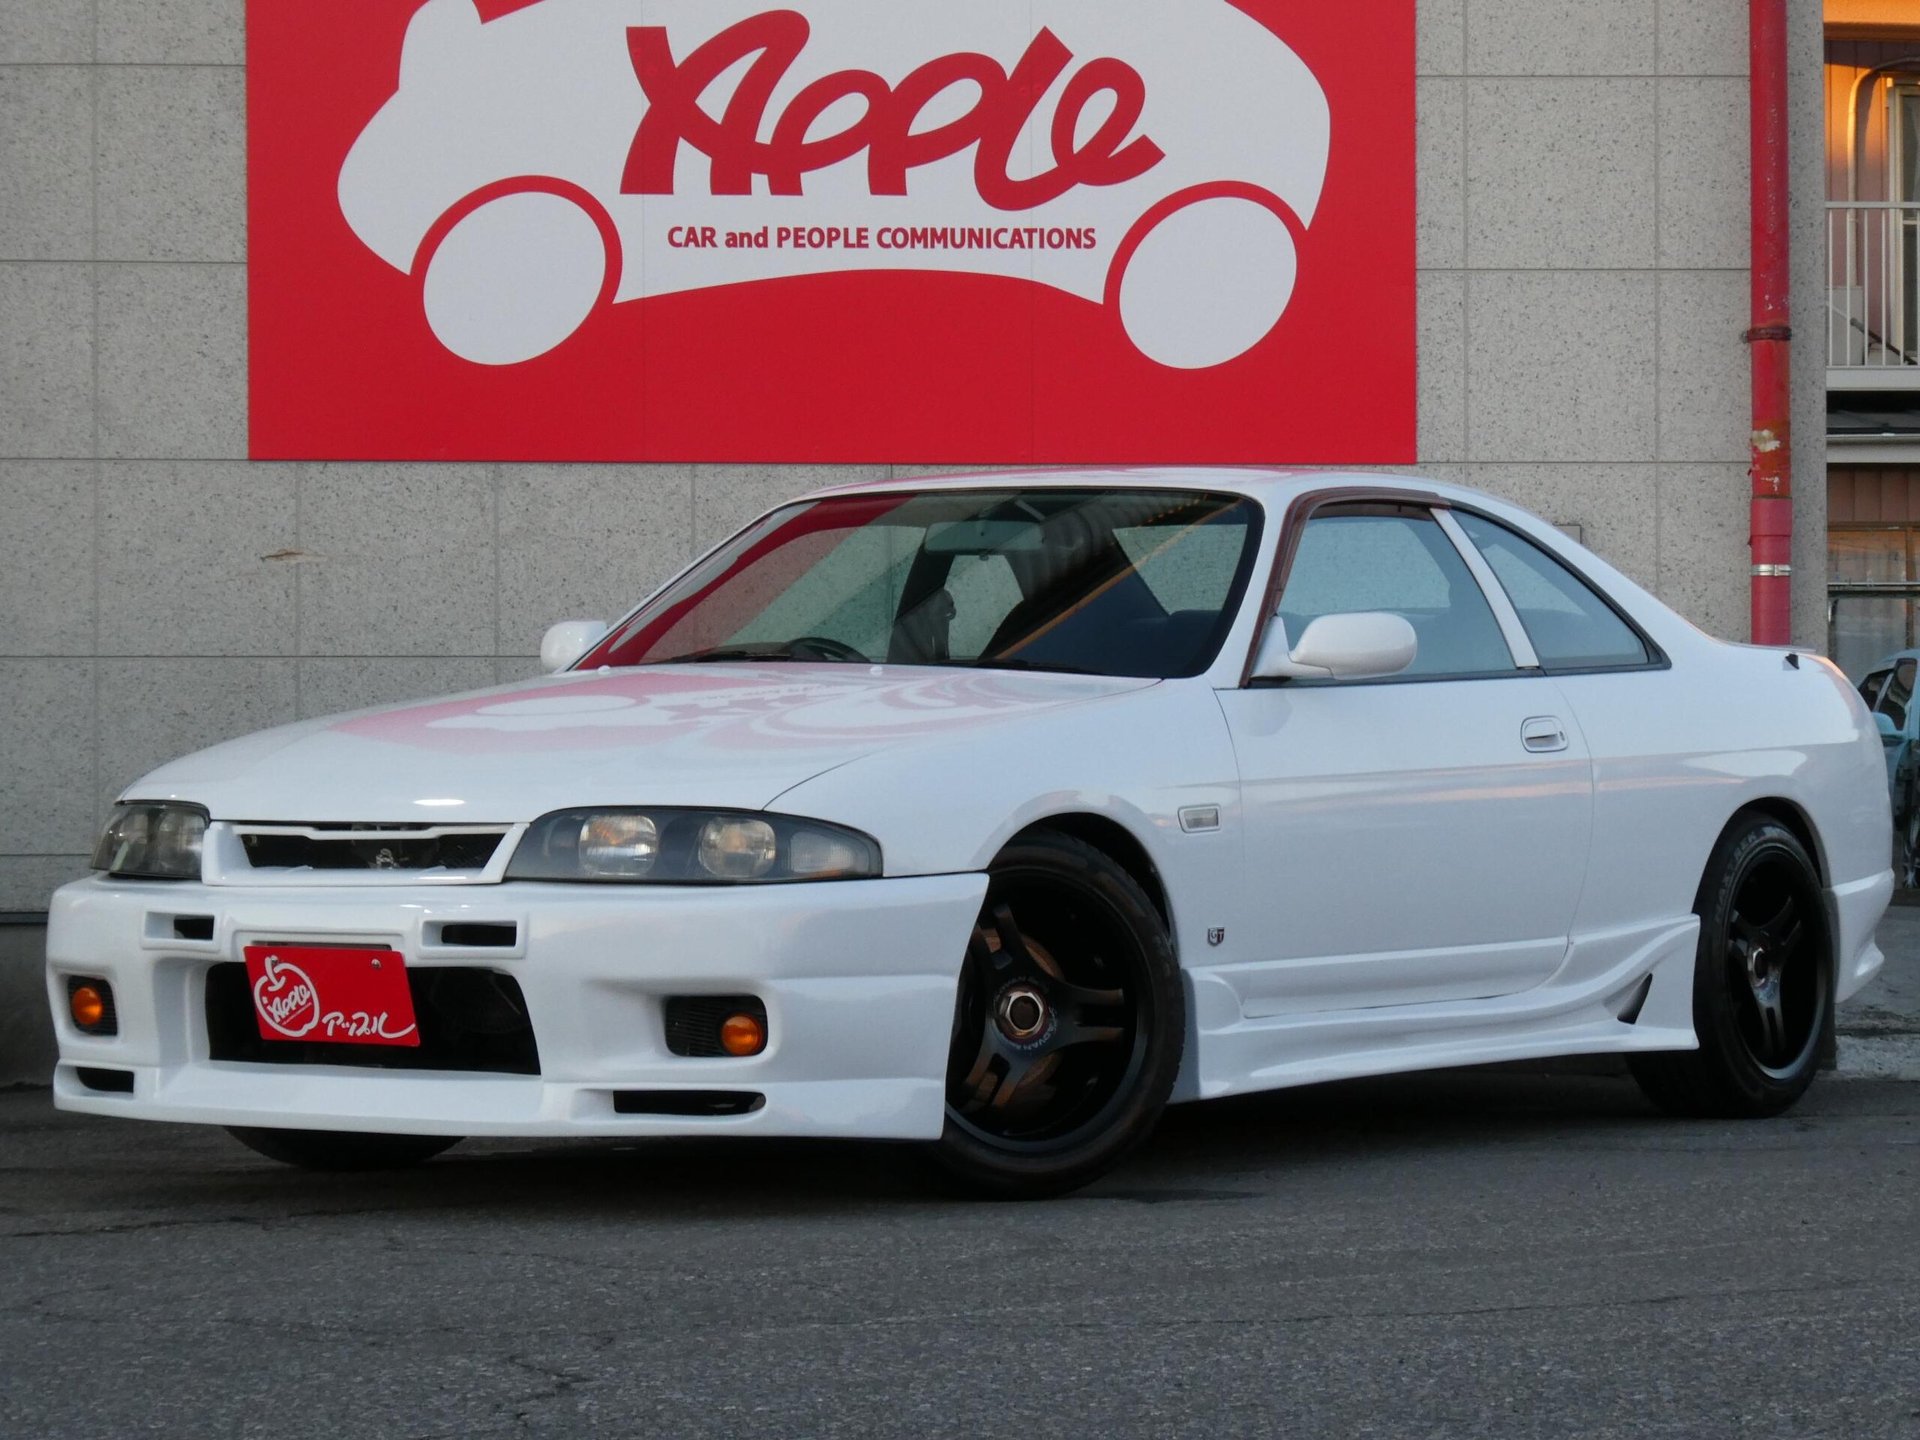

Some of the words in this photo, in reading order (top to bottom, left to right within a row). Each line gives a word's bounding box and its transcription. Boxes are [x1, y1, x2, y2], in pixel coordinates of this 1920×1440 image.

[621, 9, 1165, 211] Apple
[669, 226, 716, 249] CAR
[725, 226, 769, 249] and
[776, 226, 869, 249] PEOPLE
[876, 227, 1097, 250] COMMUNICATIONS
[266, 984, 311, 1023] Apple
